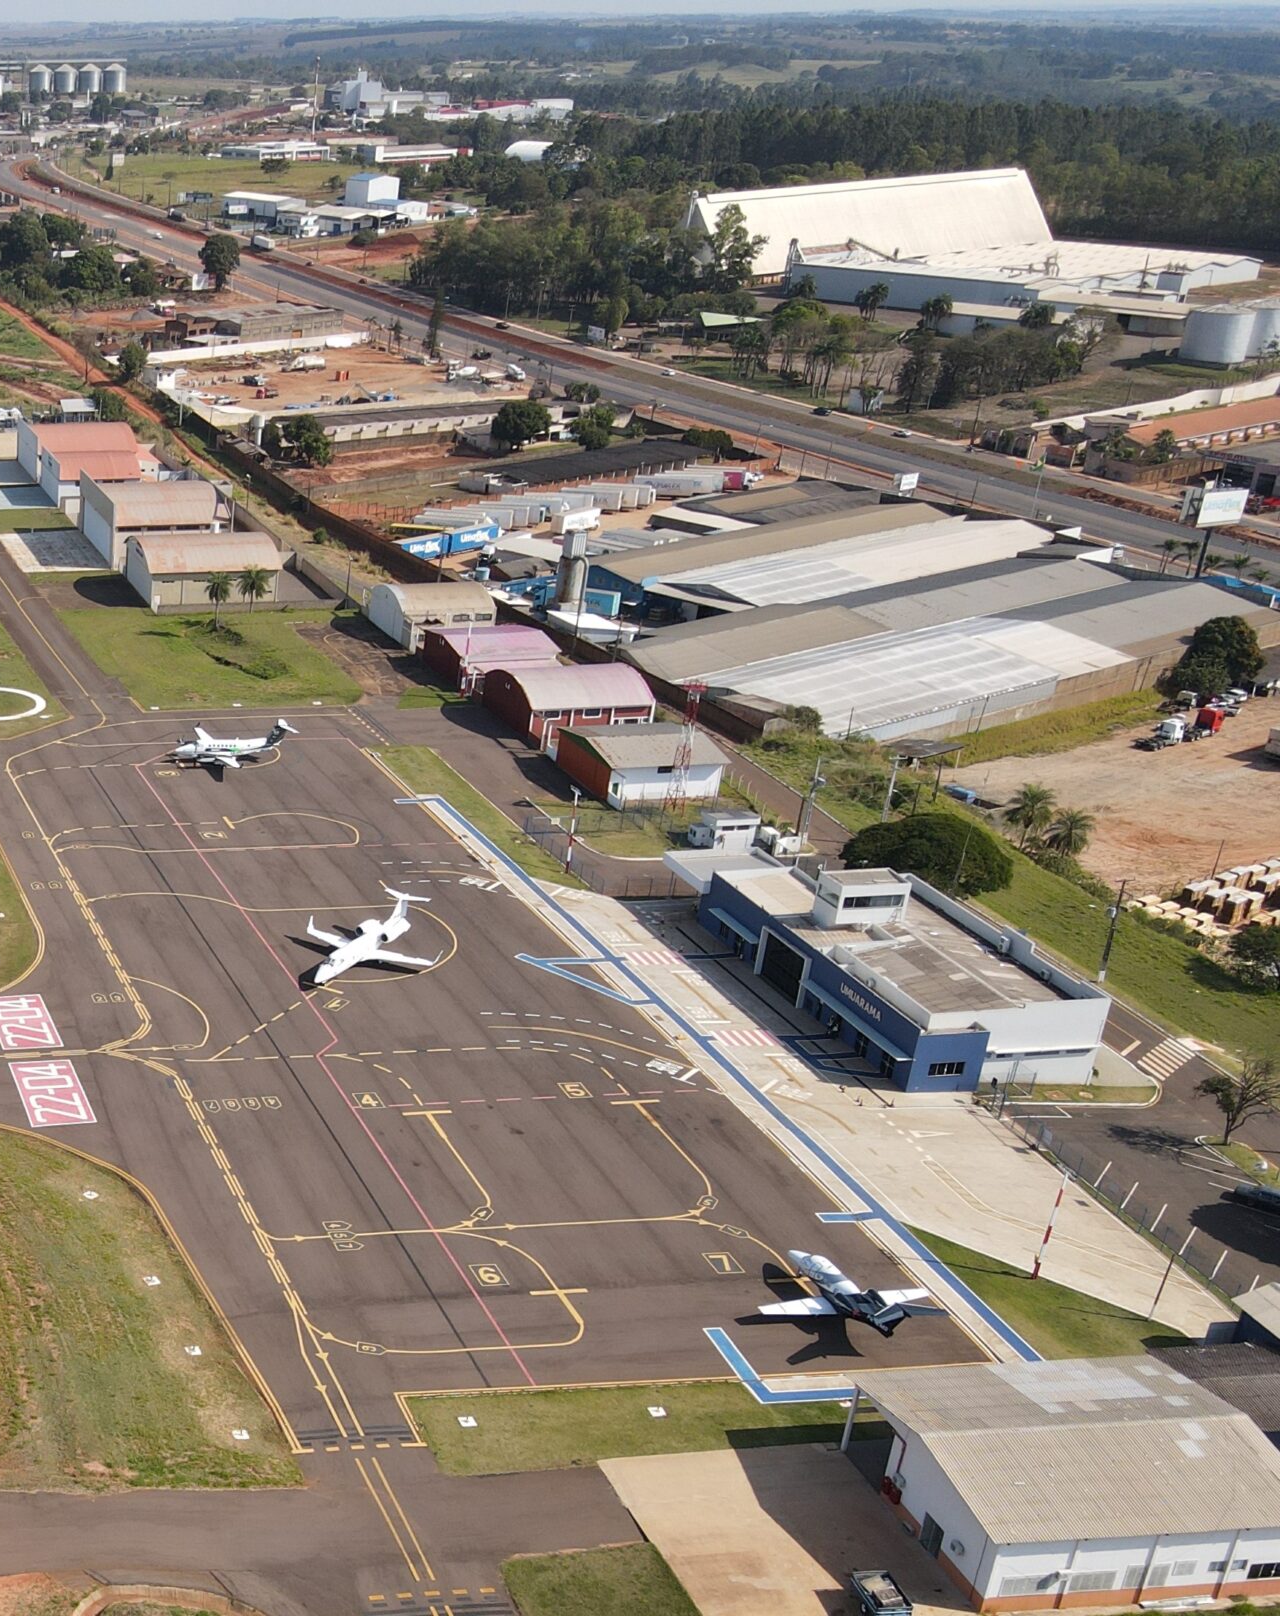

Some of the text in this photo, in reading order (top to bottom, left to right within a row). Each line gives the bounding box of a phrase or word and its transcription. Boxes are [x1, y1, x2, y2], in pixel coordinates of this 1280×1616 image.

[840, 982, 881, 1022] UMUARAMA
[16, 1063, 89, 1123] 22-04
[564, 1084, 586, 1097] 5
[361, 1094, 379, 1107] 4
[708, 1254, 732, 1272] 7
[478, 1266, 501, 1284] 6
